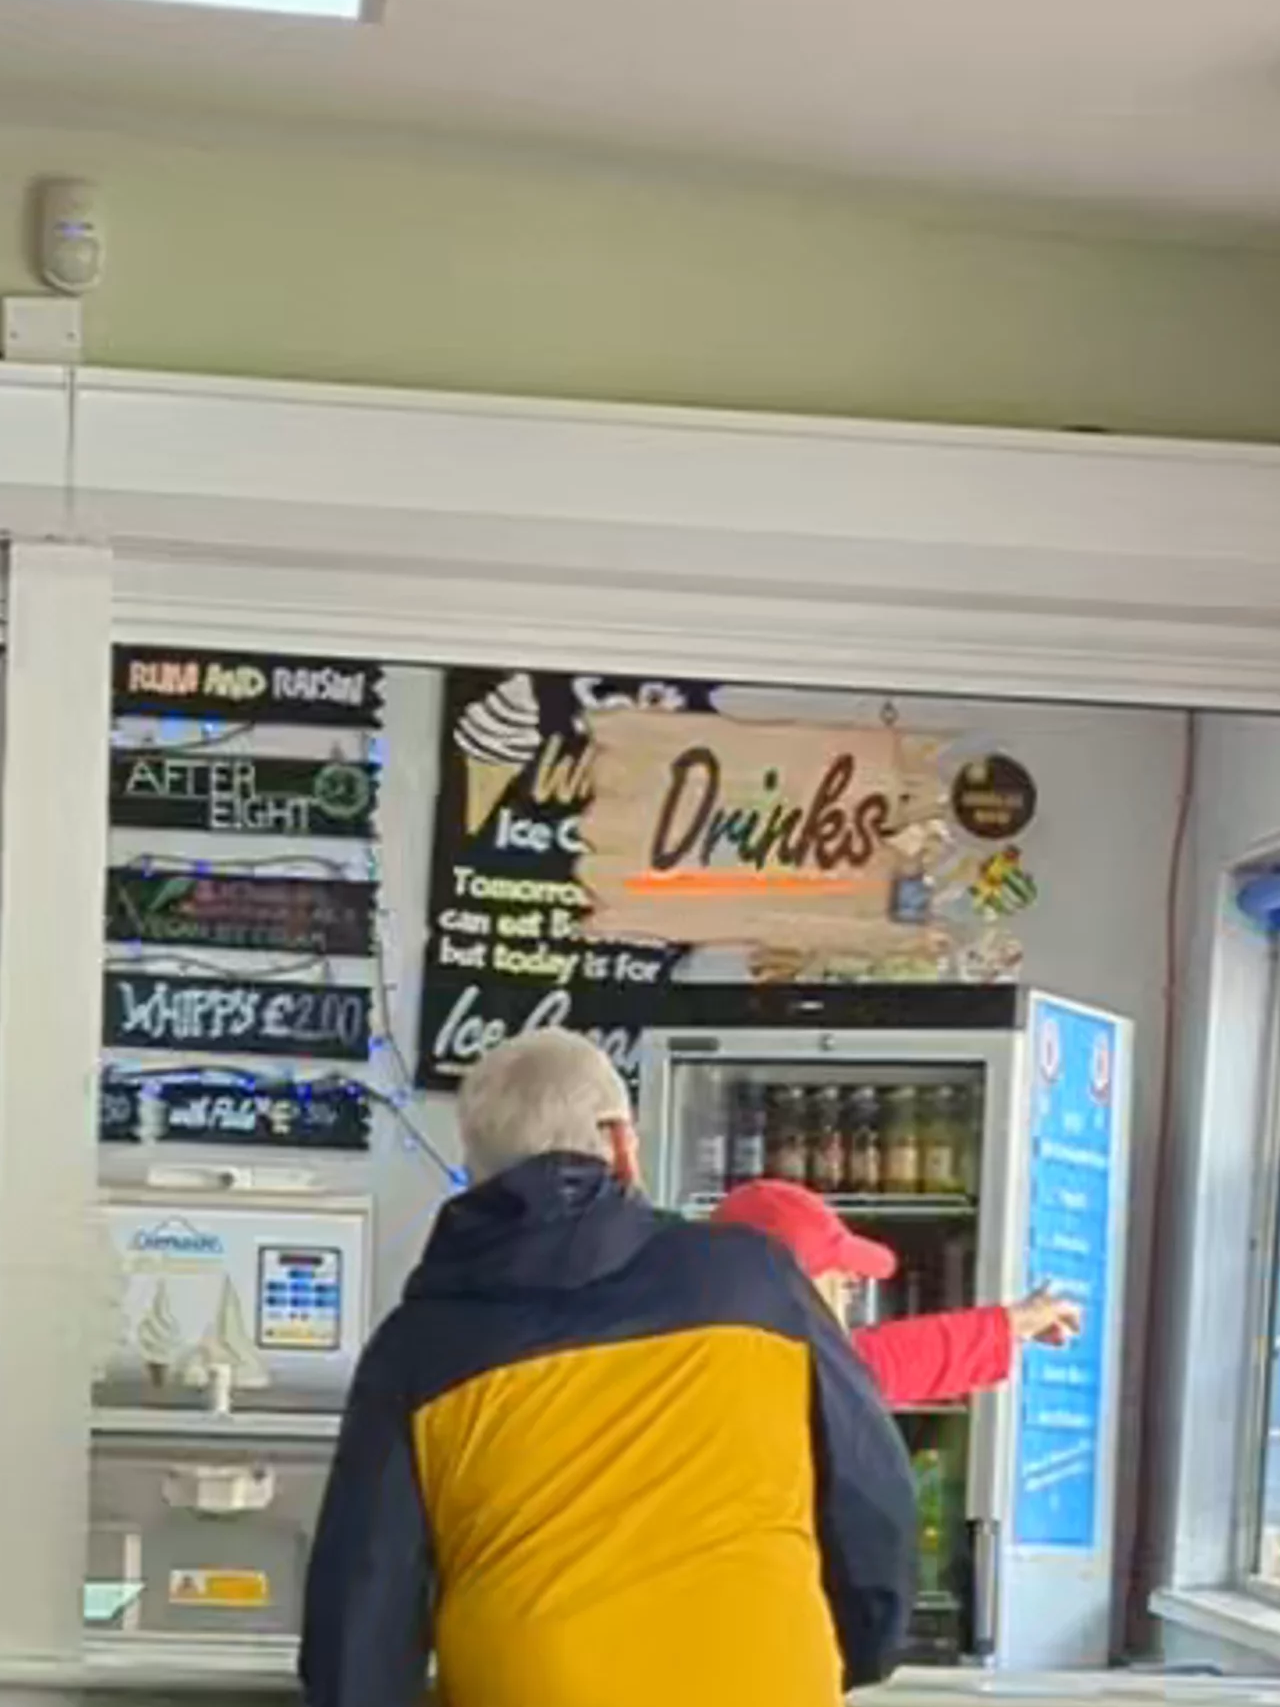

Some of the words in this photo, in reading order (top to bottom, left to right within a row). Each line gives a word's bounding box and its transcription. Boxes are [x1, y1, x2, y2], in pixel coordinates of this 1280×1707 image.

[128, 660, 199, 695] RUM
[204, 663, 267, 700] AND
[125, 757, 256, 800] AFTER
[209, 795, 317, 832] EIGHT
[651, 746, 896, 871] Drinks
[453, 866, 588, 906] Tomorro
[438, 909, 490, 934] can
[439, 937, 486, 969] but
[492, 943, 578, 985] today
[615, 952, 661, 983] for
